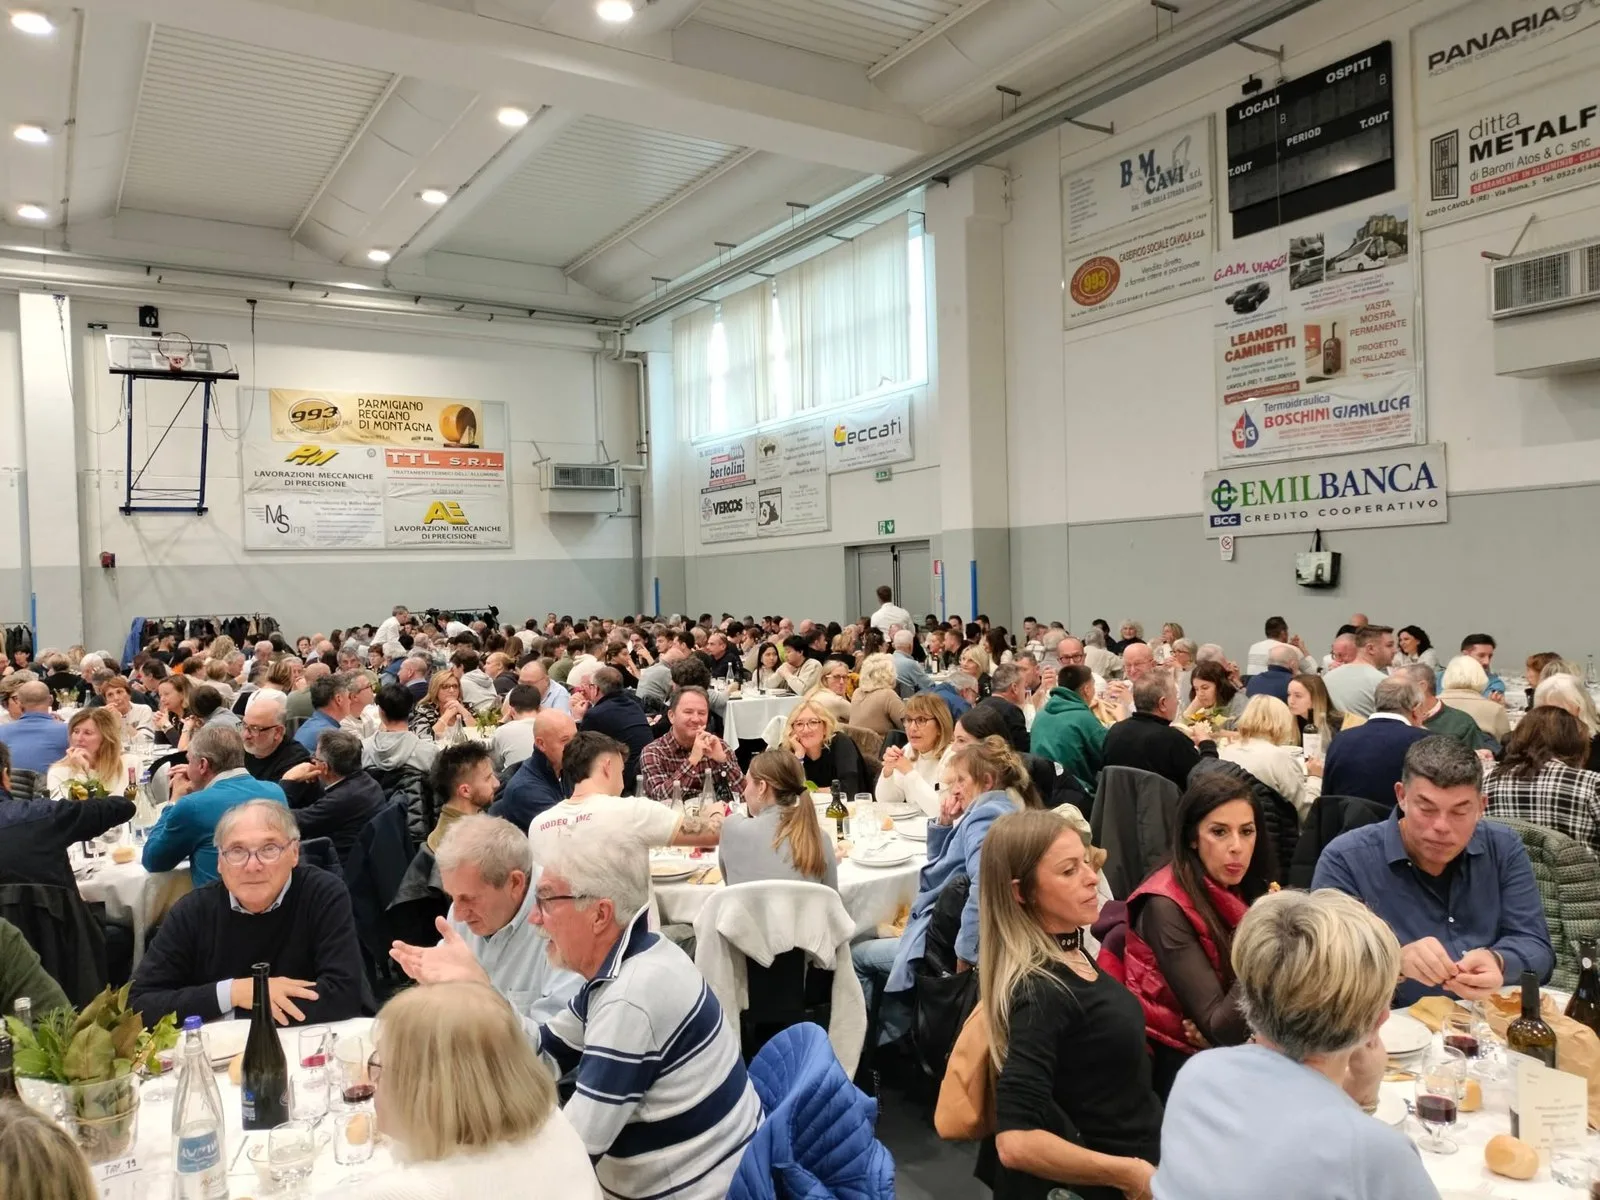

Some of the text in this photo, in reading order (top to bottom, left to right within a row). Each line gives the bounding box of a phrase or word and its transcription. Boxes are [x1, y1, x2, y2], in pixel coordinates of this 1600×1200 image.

[1326, 56, 1372, 84] OSPITI
[1239, 95, 1280, 120] LOCALI
[1359, 111, 1390, 129] T.OUT
[1469, 111, 1521, 141] ditta
[1286, 126, 1322, 147] PERIOD
[1469, 105, 1598, 164] METALF
[1228, 161, 1253, 177] T.OUT
[1470, 168, 1479, 181] di
[1481, 161, 1515, 179] Baroni
[1516, 152, 1541, 168] Atos
[1543, 148, 1552, 159] &
[1570, 137, 1592, 151] snc
[1145, 165, 1184, 195] CAVI
[1425, 206, 1446, 217] 42010
[1447, 197, 1475, 211] CAVOLA
[1477, 193, 1490, 204] (RE)
[1495, 188, 1506, 198] Via
[1542, 174, 1555, 184] Tel.
[1119, 246, 1147, 262] CASEIFICIO
[1146, 239, 1169, 254] SOCIALE
[1169, 231, 1192, 246] CAVOLA
[1214, 263, 1249, 281] G.A.M.
[1252, 252, 1288, 273] VIAGGI
[1083, 269, 1107, 293] 993
[1364, 299, 1392, 312] VASTA
[1360, 309, 1397, 324] MOSTRA
[1231, 323, 1288, 347] LEANDRI
[1350, 319, 1408, 337] PERMANENTE
[1224, 336, 1297, 363] CAMINETTI
[1357, 338, 1399, 352] PROGETTO
[1349, 348, 1407, 365] INSTALLAZIONE
[358, 398, 424, 411] PARMIGIANO
[1263, 393, 1331, 413] Termoidraulica
[1264, 407, 1330, 429] BOSCHINI
[1332, 395, 1410, 419] GIANLUCA
[291, 406, 338, 424] 993
[358, 409, 411, 421] REGGIANO
[359, 419, 370, 430] DI
[373, 420, 433, 433] MONTAGNA
[387, 451, 503, 467] TTL S.R.L.
[710, 459, 746, 479] bertolini
[254, 470, 374, 480] LAVORAZIONI MECCANICHE
[1240, 461, 1438, 508] EMILBANCA
[713, 498, 743, 515] VERCOS
[1213, 499, 1438, 526] BCC CREDITO COOPERATIVO
[540, 812, 592, 831] RODEO IME
